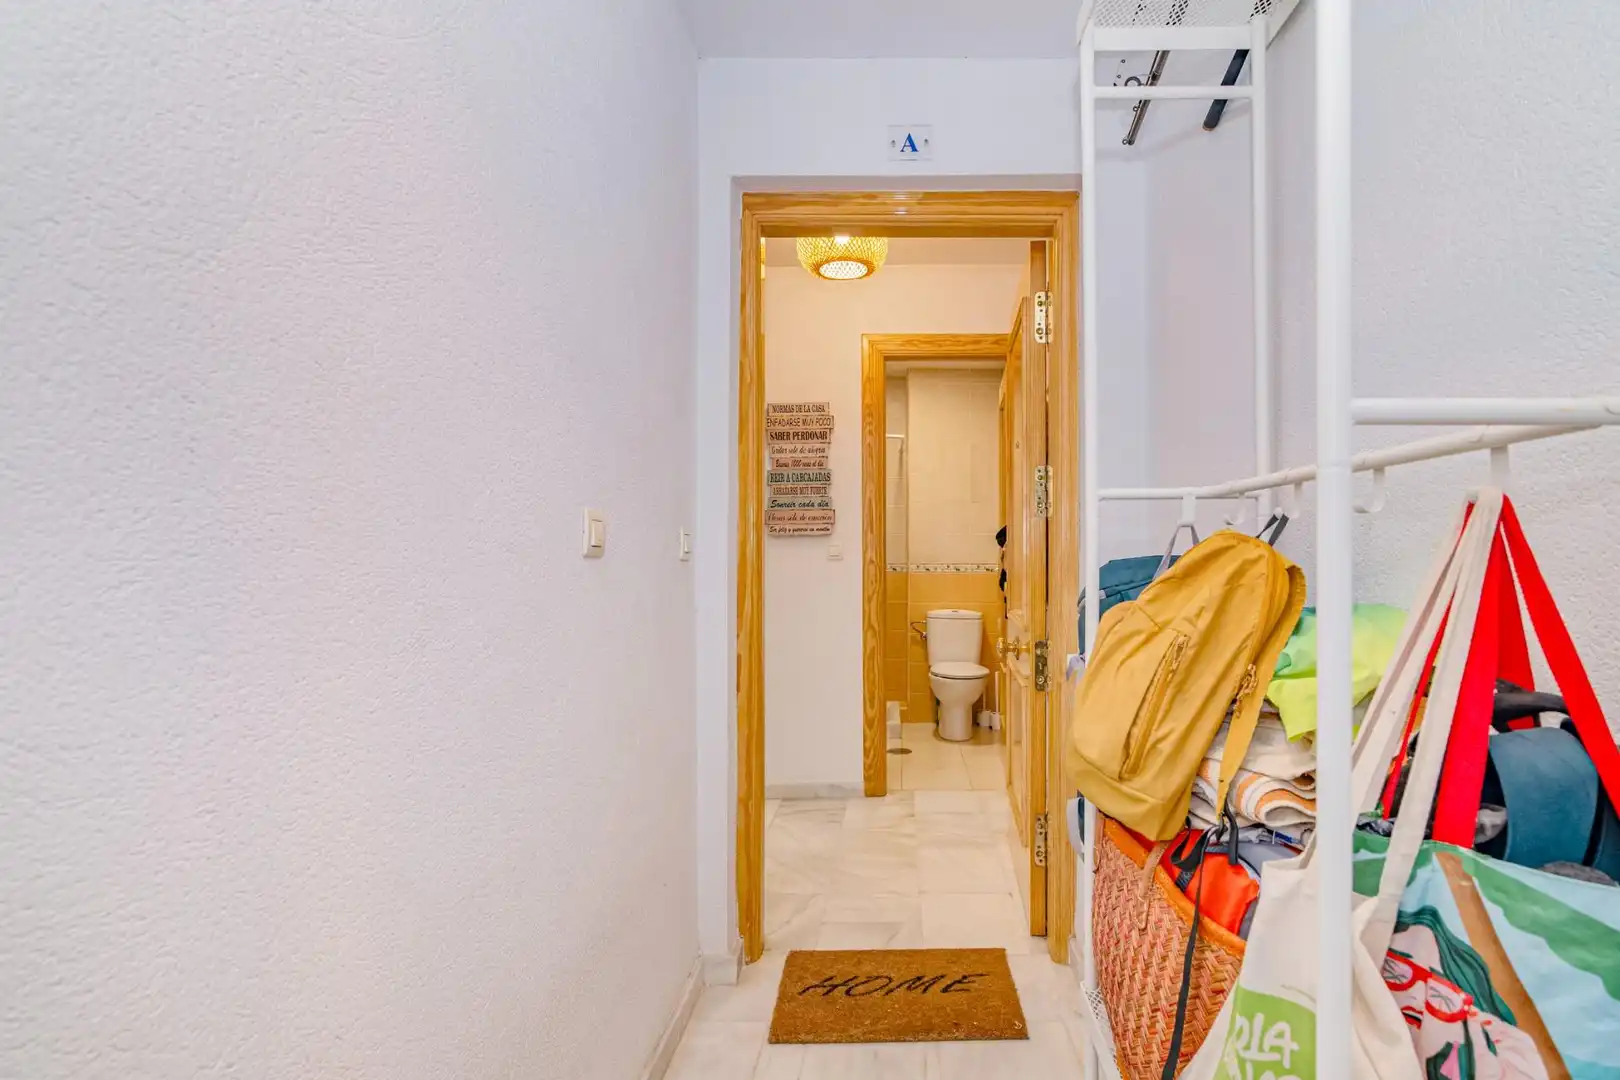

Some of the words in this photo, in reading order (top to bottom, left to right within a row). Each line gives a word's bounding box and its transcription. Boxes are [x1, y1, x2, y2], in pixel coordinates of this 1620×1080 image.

[900, 132, 919, 152] A
[772, 404, 794, 413] NORMAS
[796, 404, 803, 412] DE
[804, 404, 810, 412] LA
[811, 404, 826, 412] CASA
[766, 417, 800, 428] ENFADARSE
[802, 418, 814, 427] MUY
[816, 417, 831, 427] POCO
[770, 431, 790, 440] SABER
[792, 430, 828, 440] PERDONAR
[786, 472, 790, 482] A
[792, 472, 830, 482] CARCAJADAS
[798, 500, 815, 508] cada
[800, 974, 990, 997] HOME
